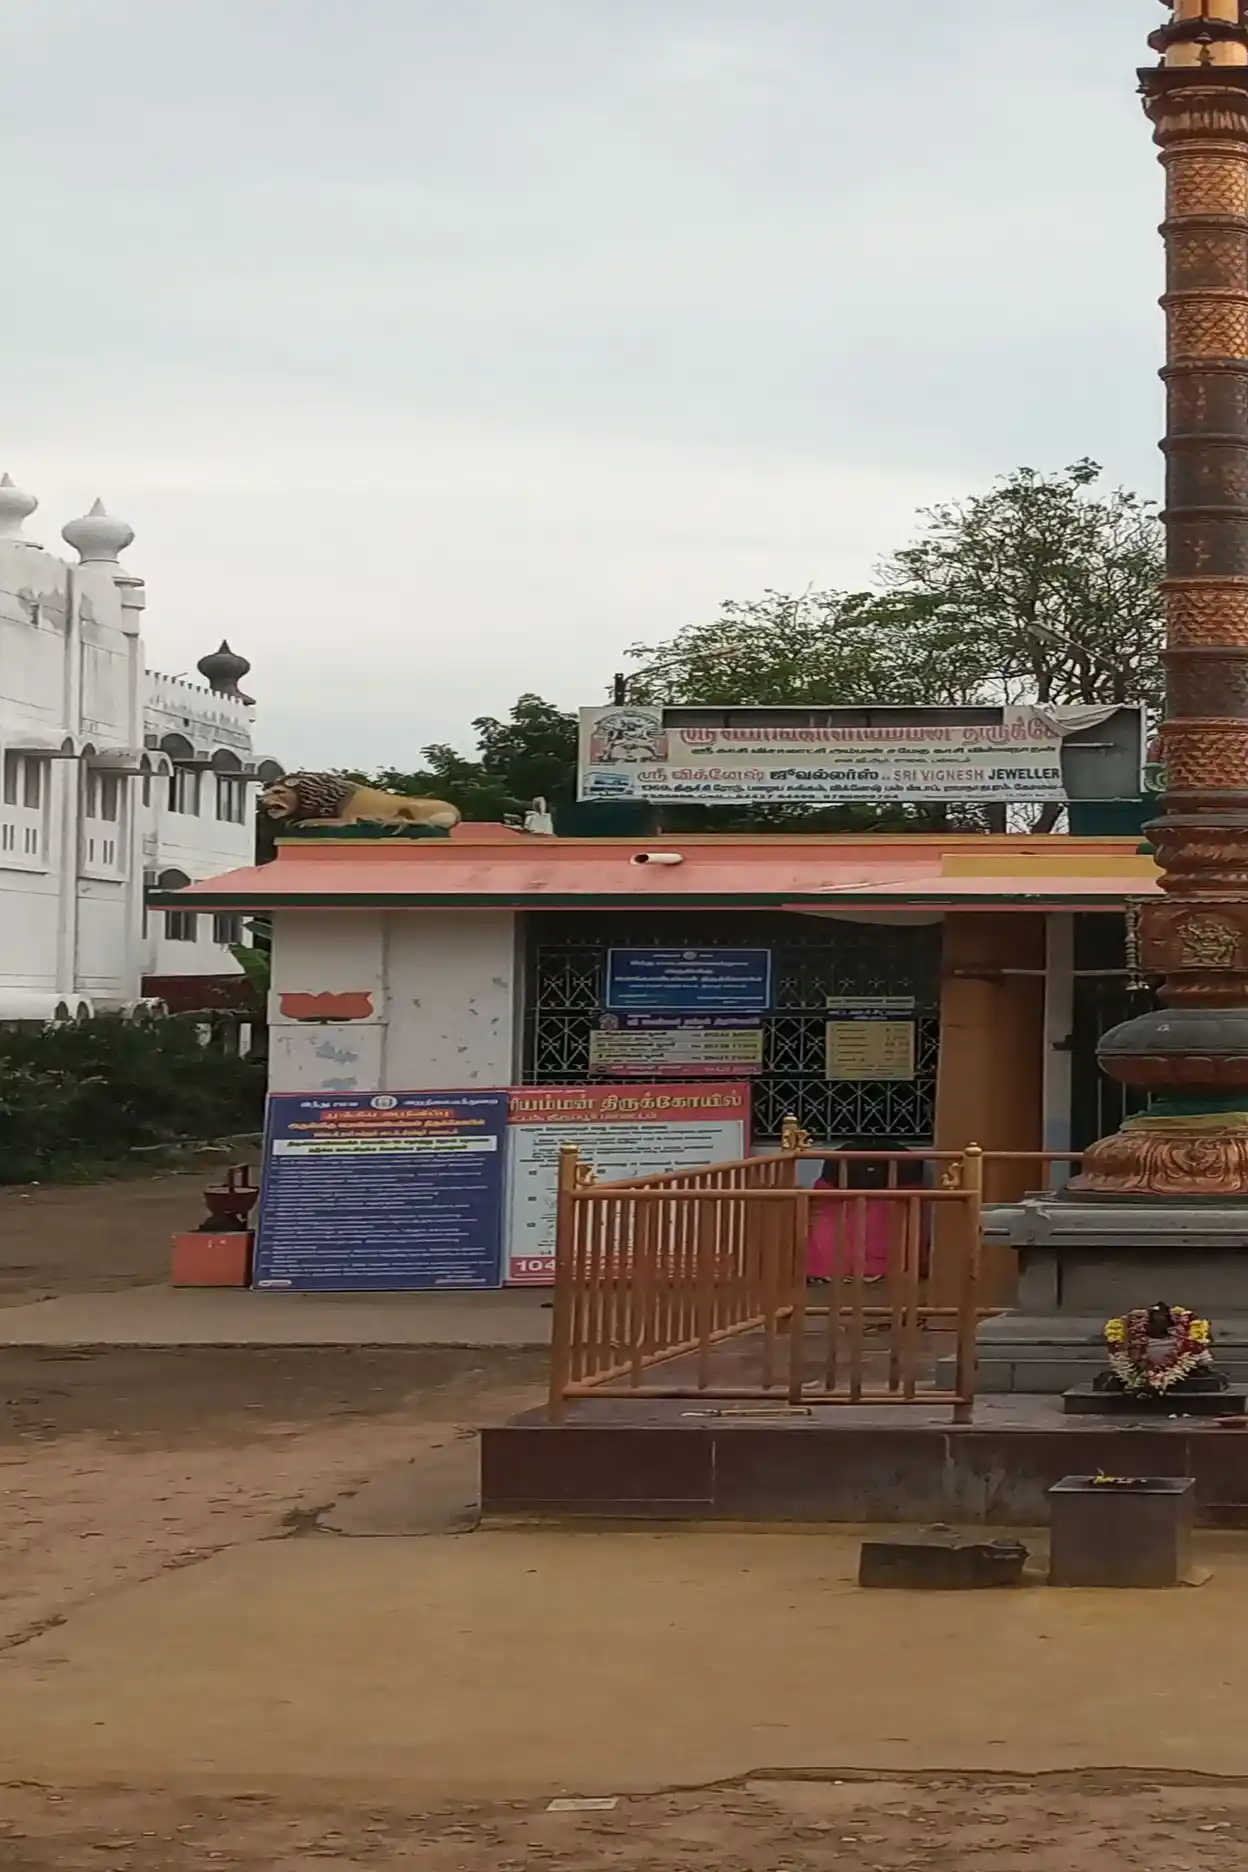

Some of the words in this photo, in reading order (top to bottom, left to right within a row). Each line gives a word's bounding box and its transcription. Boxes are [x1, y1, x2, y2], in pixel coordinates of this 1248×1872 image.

[894, 769, 917, 781] SRI
[920, 769, 985, 781] VIGNESH
[600, 1089, 742, 1112] திருக்கோயில்
